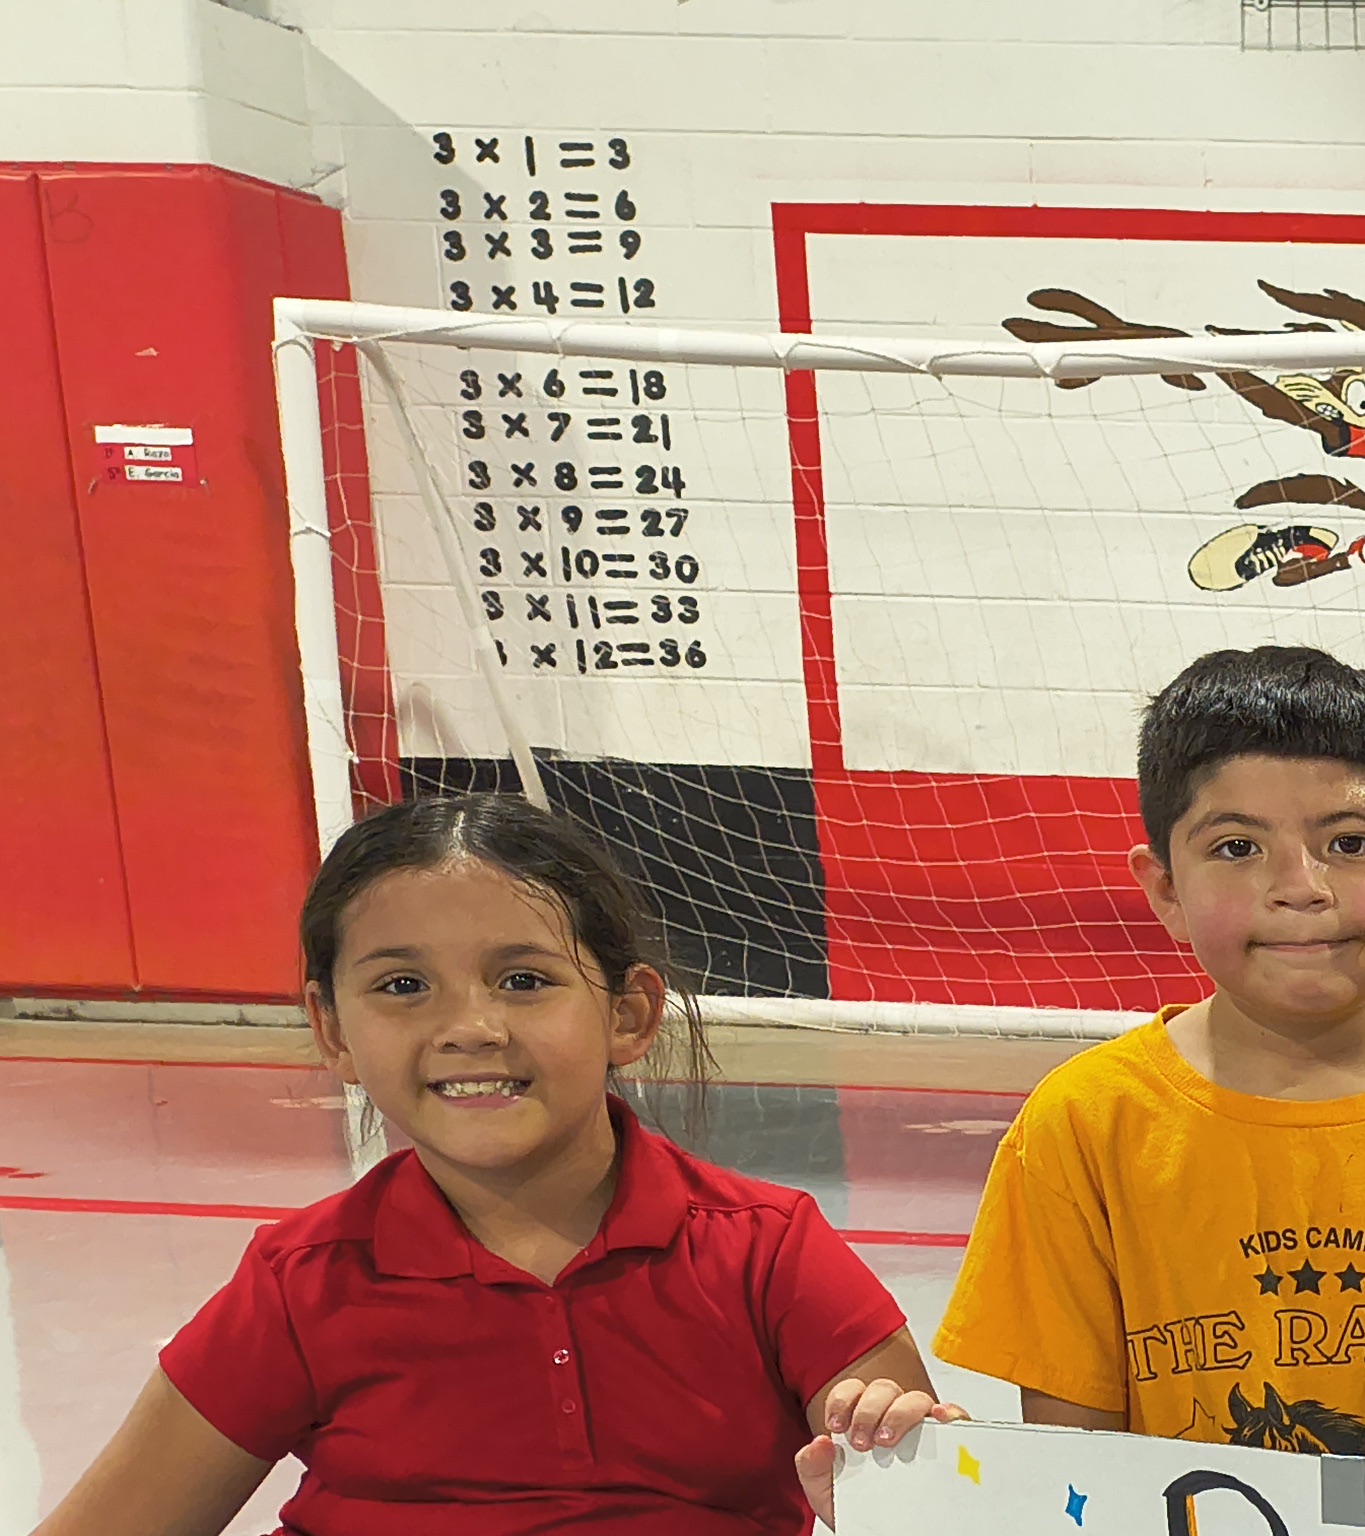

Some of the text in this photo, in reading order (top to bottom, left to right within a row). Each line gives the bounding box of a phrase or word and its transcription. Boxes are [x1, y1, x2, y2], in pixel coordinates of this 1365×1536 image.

[432, 132, 456, 165] 3
[524, 135, 536, 177] 1
[608, 138, 631, 170] 3
[439, 189, 462, 221] 3
[528, 190, 552, 221] 2
[614, 189, 636, 221] 6
[443, 228, 641, 262] 3 3 9
[449, 276, 656, 315] 3 4 12
[459, 368, 667, 406] 3 6 18
[462, 409, 671, 451] 3 7 21
[467, 460, 686, 499] 3 8 24
[473, 501, 689, 538] 3 9 27
[479, 545, 700, 584] 3 10 30
[481, 590, 700, 630] 3 11 33
[575, 638, 707, 675] 12 36
[1239, 1227, 1299, 1259] KIDS
[1127, 1310, 1252, 1382] THE
